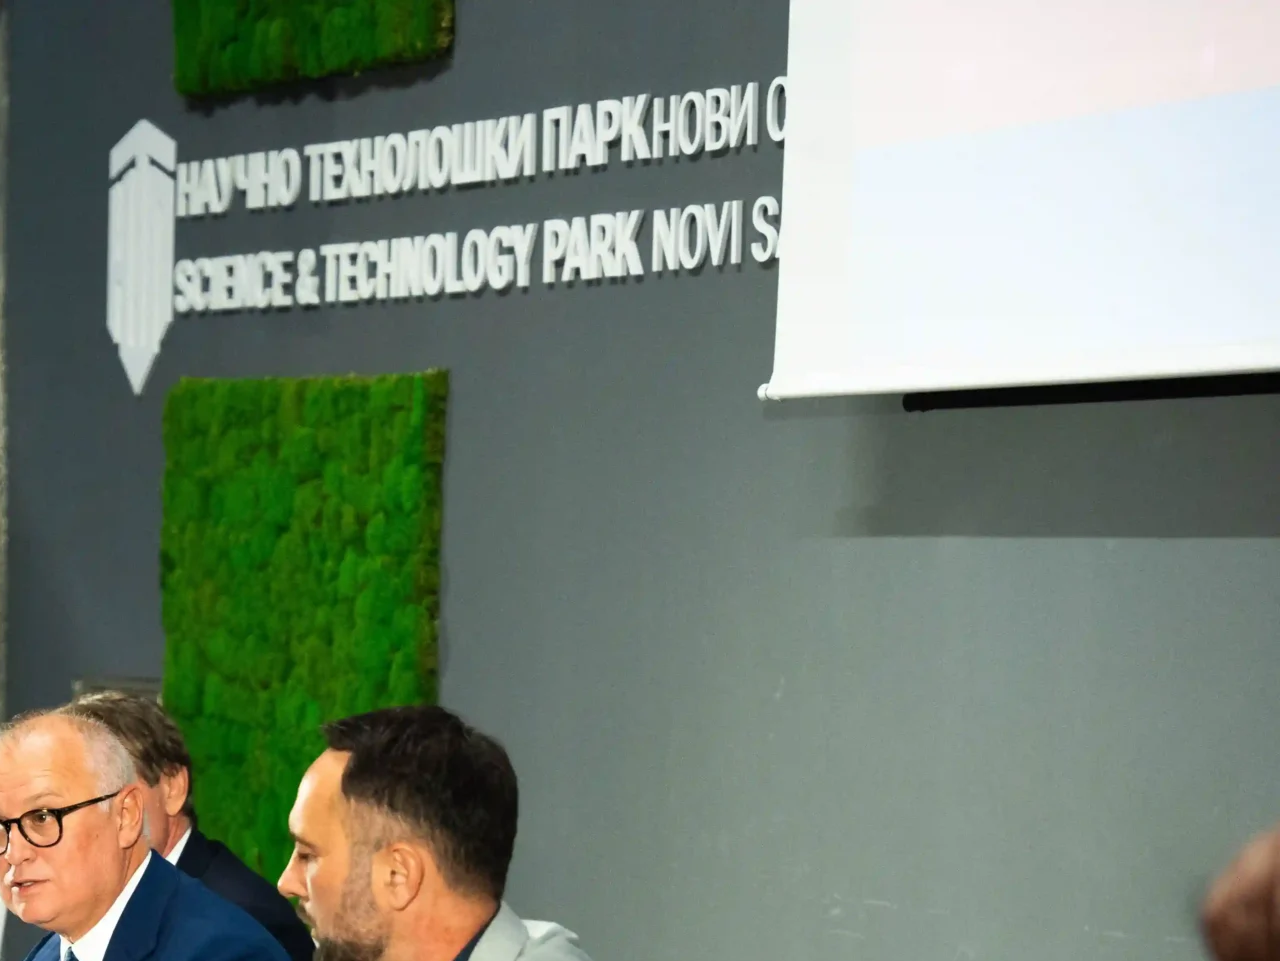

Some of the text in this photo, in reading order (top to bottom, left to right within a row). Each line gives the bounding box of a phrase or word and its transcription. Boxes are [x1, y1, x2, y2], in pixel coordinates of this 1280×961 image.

[176, 148, 302, 216] НАУЧНО
[304, 113, 536, 201] ТЕХНОЛОШКИ
[542, 93, 651, 172] ПАРК
[652, 82, 759, 158] НОВИ
[174, 196, 782, 312] SCIENCE & TECHNOLOGY PARK NOVI S
